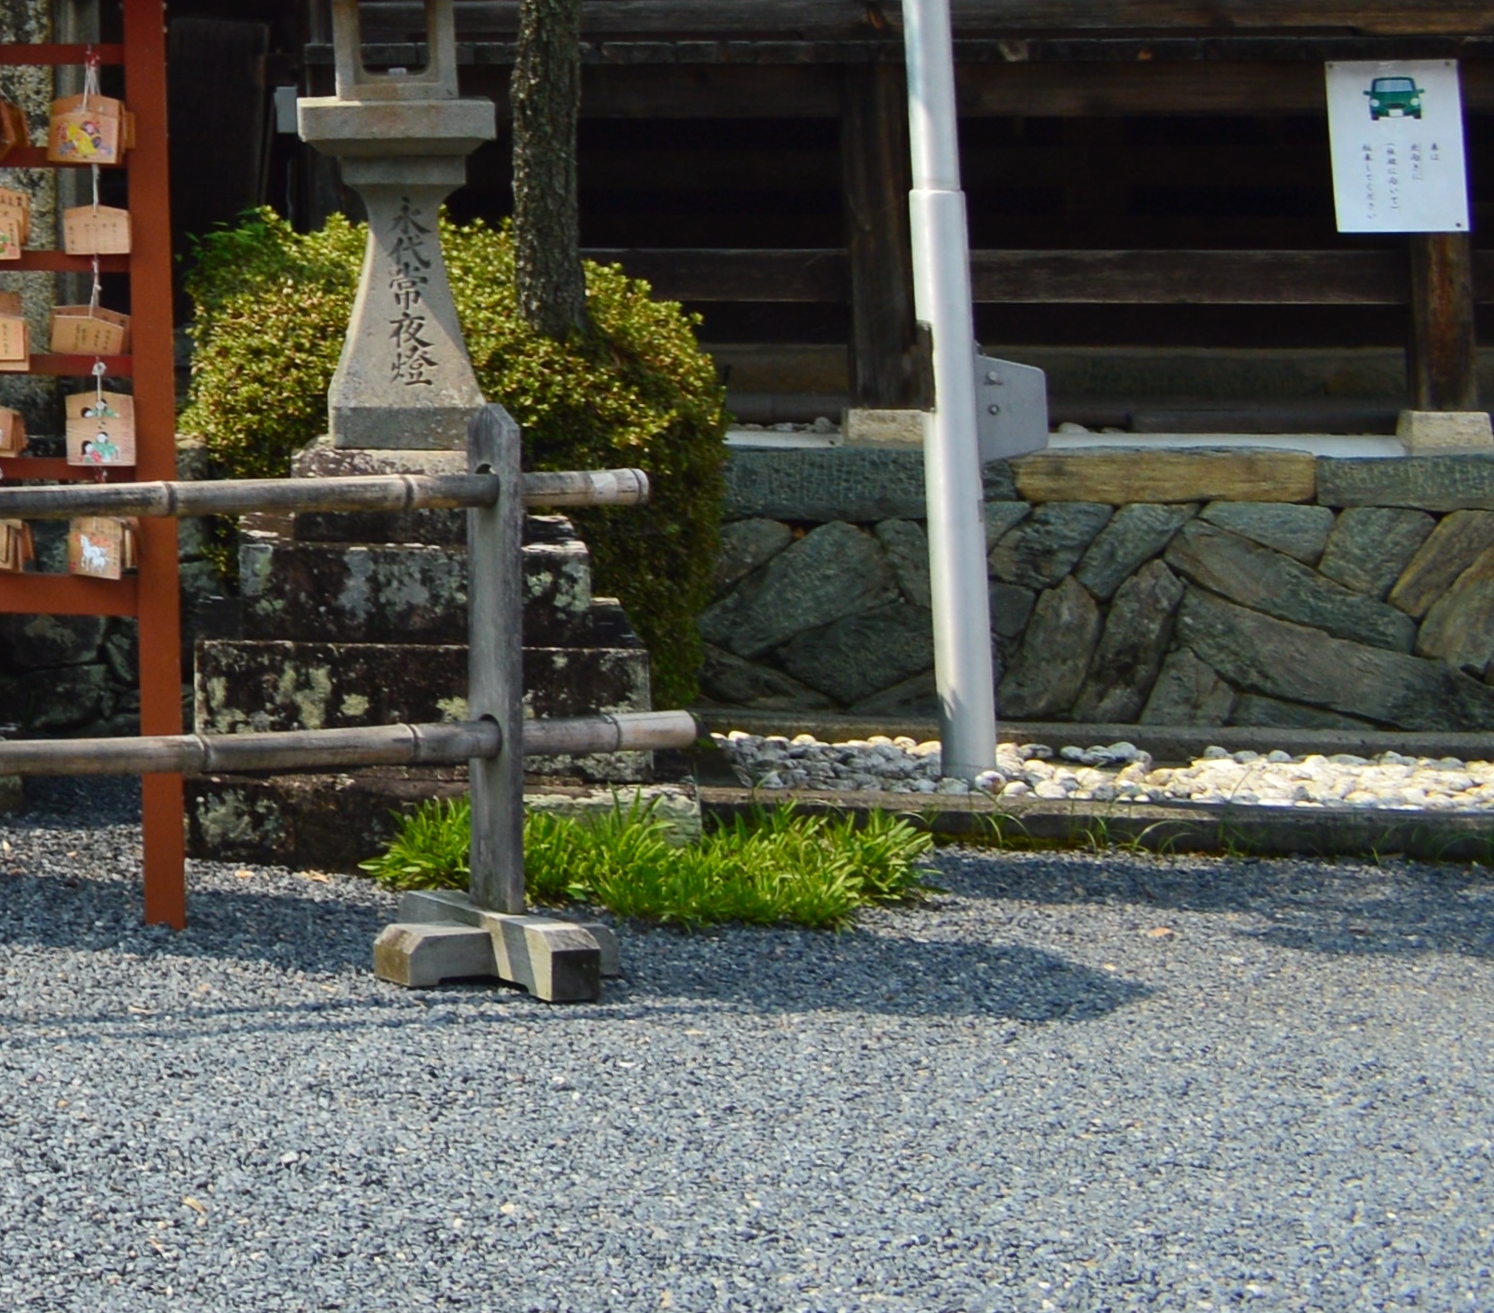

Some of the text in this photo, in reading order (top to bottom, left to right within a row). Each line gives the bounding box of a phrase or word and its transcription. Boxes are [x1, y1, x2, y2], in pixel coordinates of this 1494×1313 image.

[387, 196, 439, 386] 永代常夜燈
